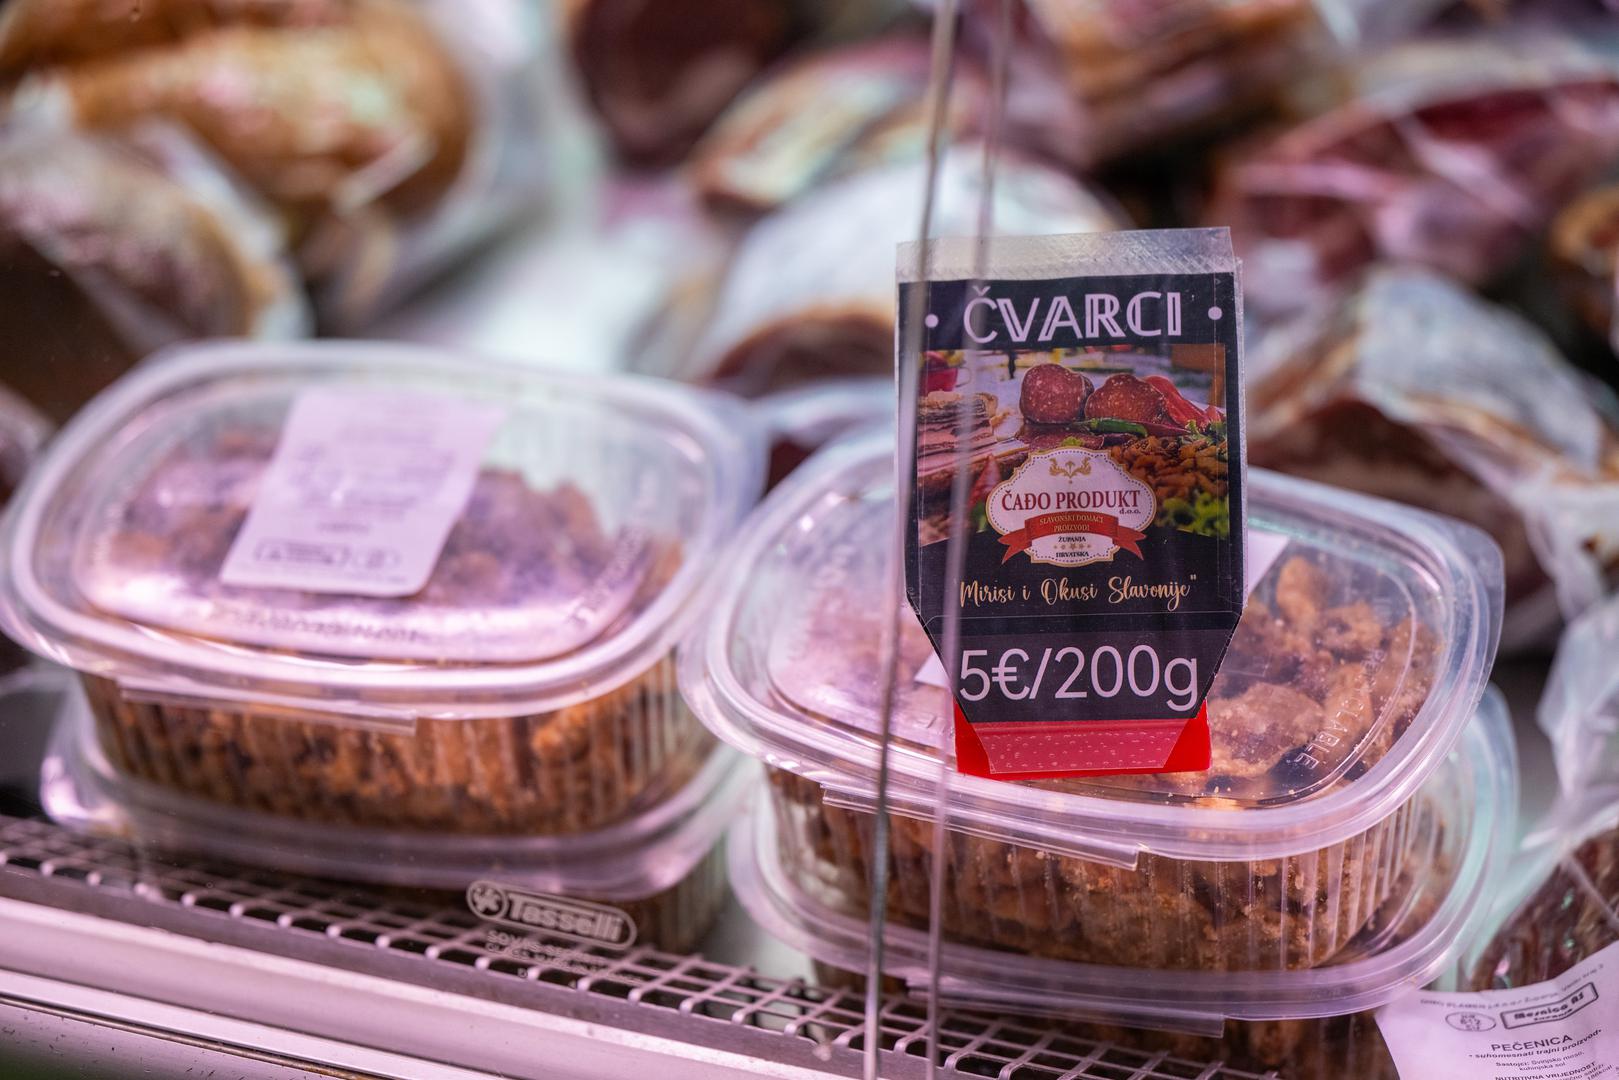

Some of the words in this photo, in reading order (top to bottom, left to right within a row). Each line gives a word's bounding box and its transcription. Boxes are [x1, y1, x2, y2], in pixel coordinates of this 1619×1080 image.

[963, 285, 1182, 343] ČVARCI
[1001, 490, 1050, 511] ČAĐO
[1056, 489, 1141, 509] PRODUKT
[1039, 514, 1076, 525] SLAVONSKI
[1053, 524, 1090, 532] PROIZVODI
[1022, 581, 1031, 600] i
[1040, 577, 1098, 605] Okusi
[959, 644, 1198, 712] 5€/200g
[508, 892, 624, 942] Tasselli
[1491, 1034, 1573, 1051] PEČENICA
[1536, 1047, 1560, 1055] trajni
[1545, 1061, 1596, 1079] VRIJEDNOST
